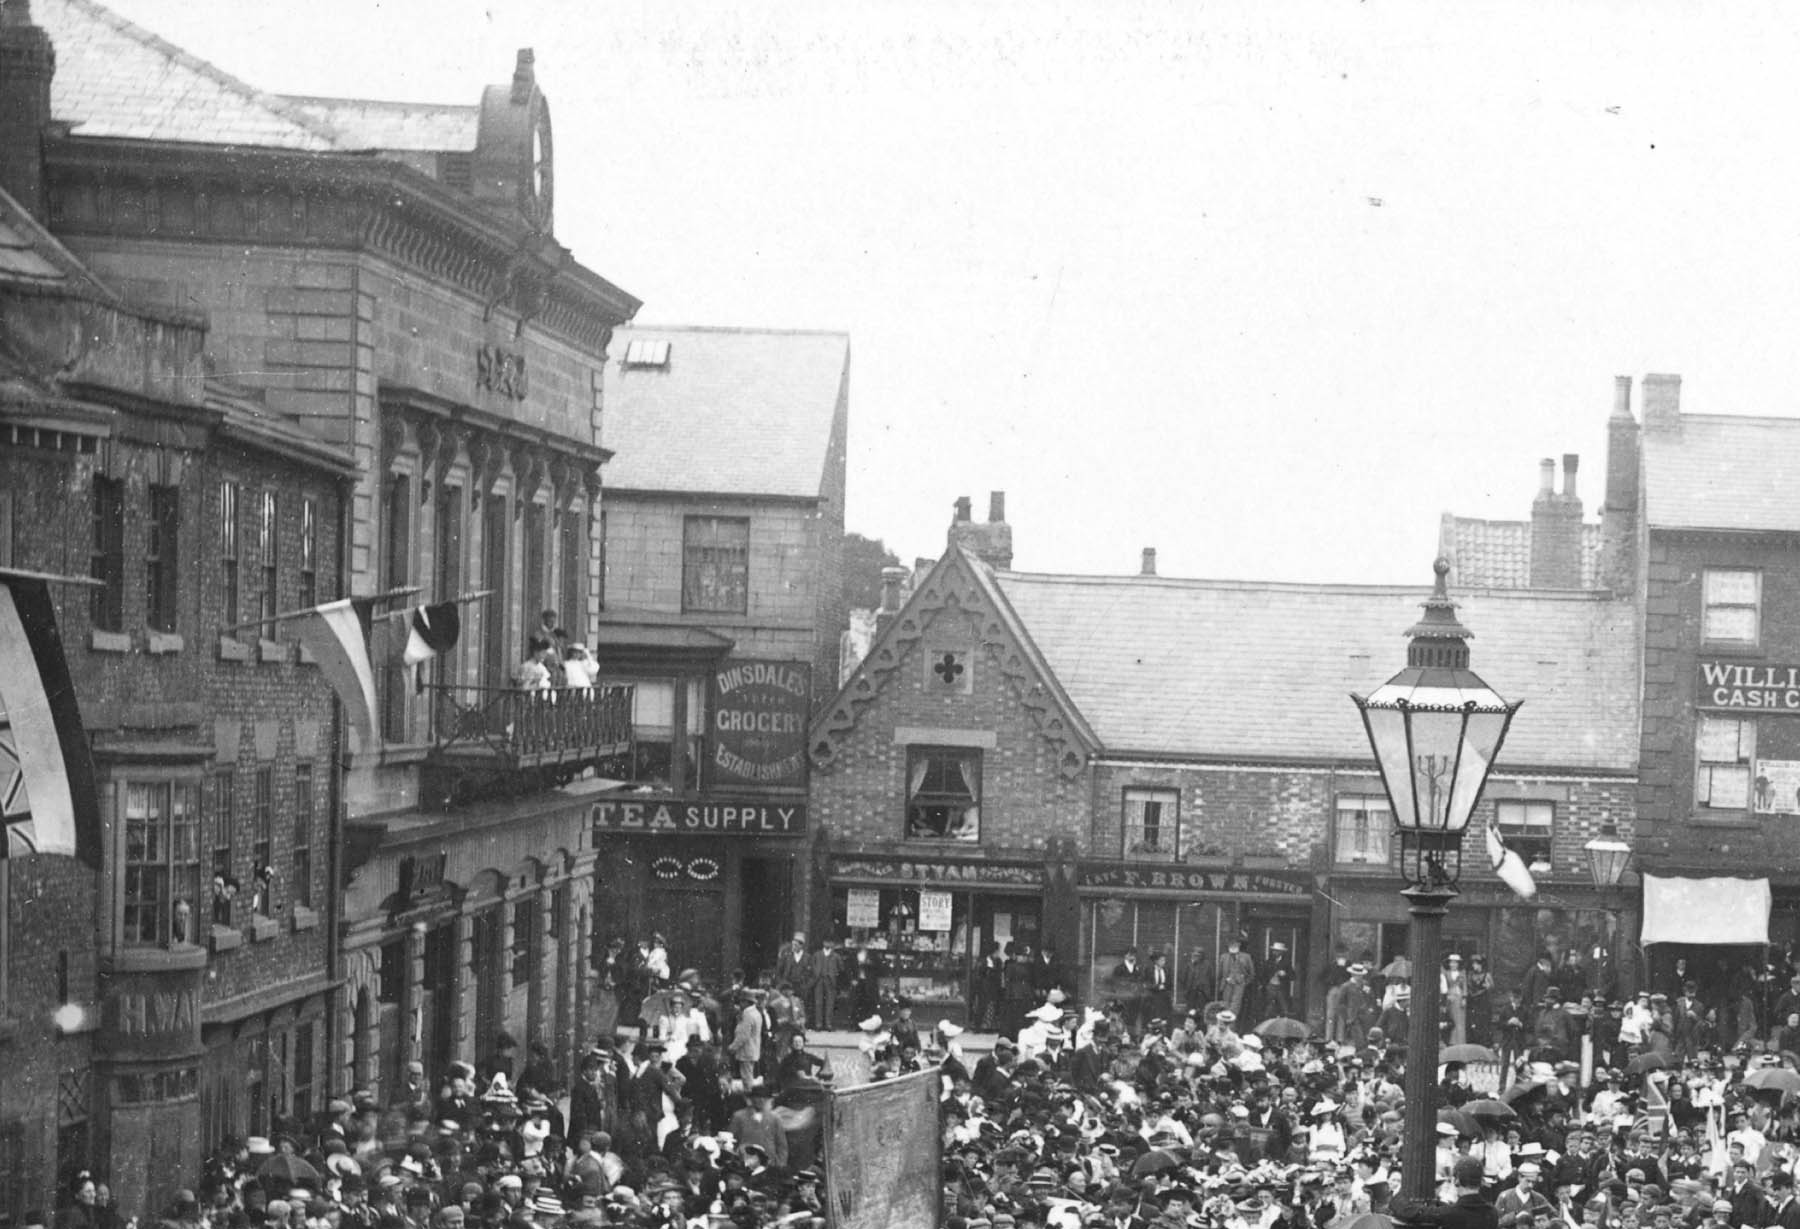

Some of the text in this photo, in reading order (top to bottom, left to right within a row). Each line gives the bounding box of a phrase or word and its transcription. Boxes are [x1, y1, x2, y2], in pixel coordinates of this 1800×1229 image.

[1713, 687, 1777, 708] CASH
[716, 708, 803, 733] GROCERY
[592, 802, 794, 829] TEA SUPPLY
